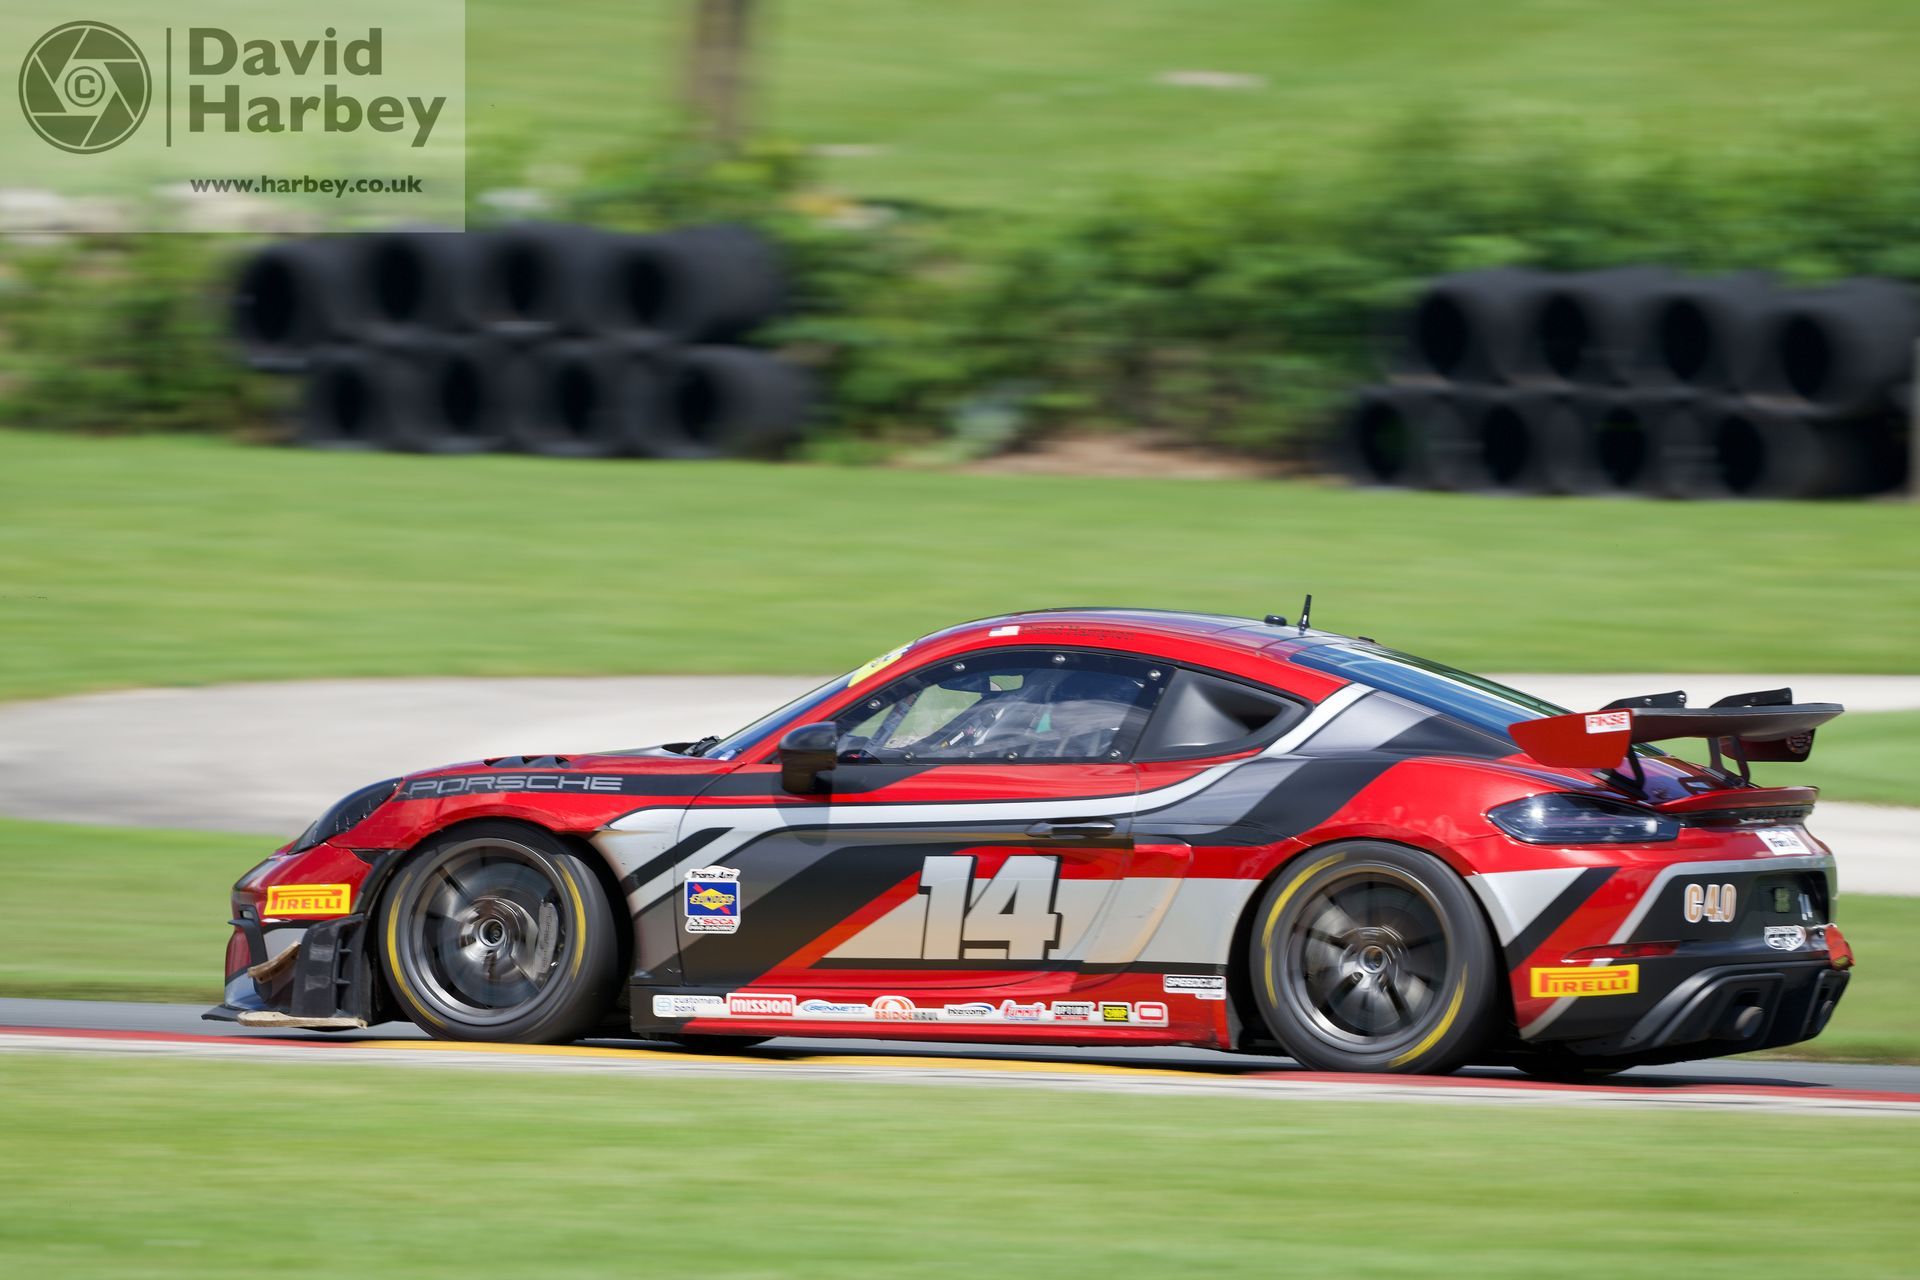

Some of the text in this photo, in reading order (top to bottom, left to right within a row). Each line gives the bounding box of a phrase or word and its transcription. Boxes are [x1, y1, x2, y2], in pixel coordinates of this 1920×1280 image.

[408, 775, 624, 796] PORSCHE
[269, 889, 343, 911] PIRELLI
[689, 894, 735, 904] SUNOCO
[918, 855, 1063, 960] 14
[1684, 883, 1737, 923] C40
[1540, 969, 1630, 994] PIRELLI
